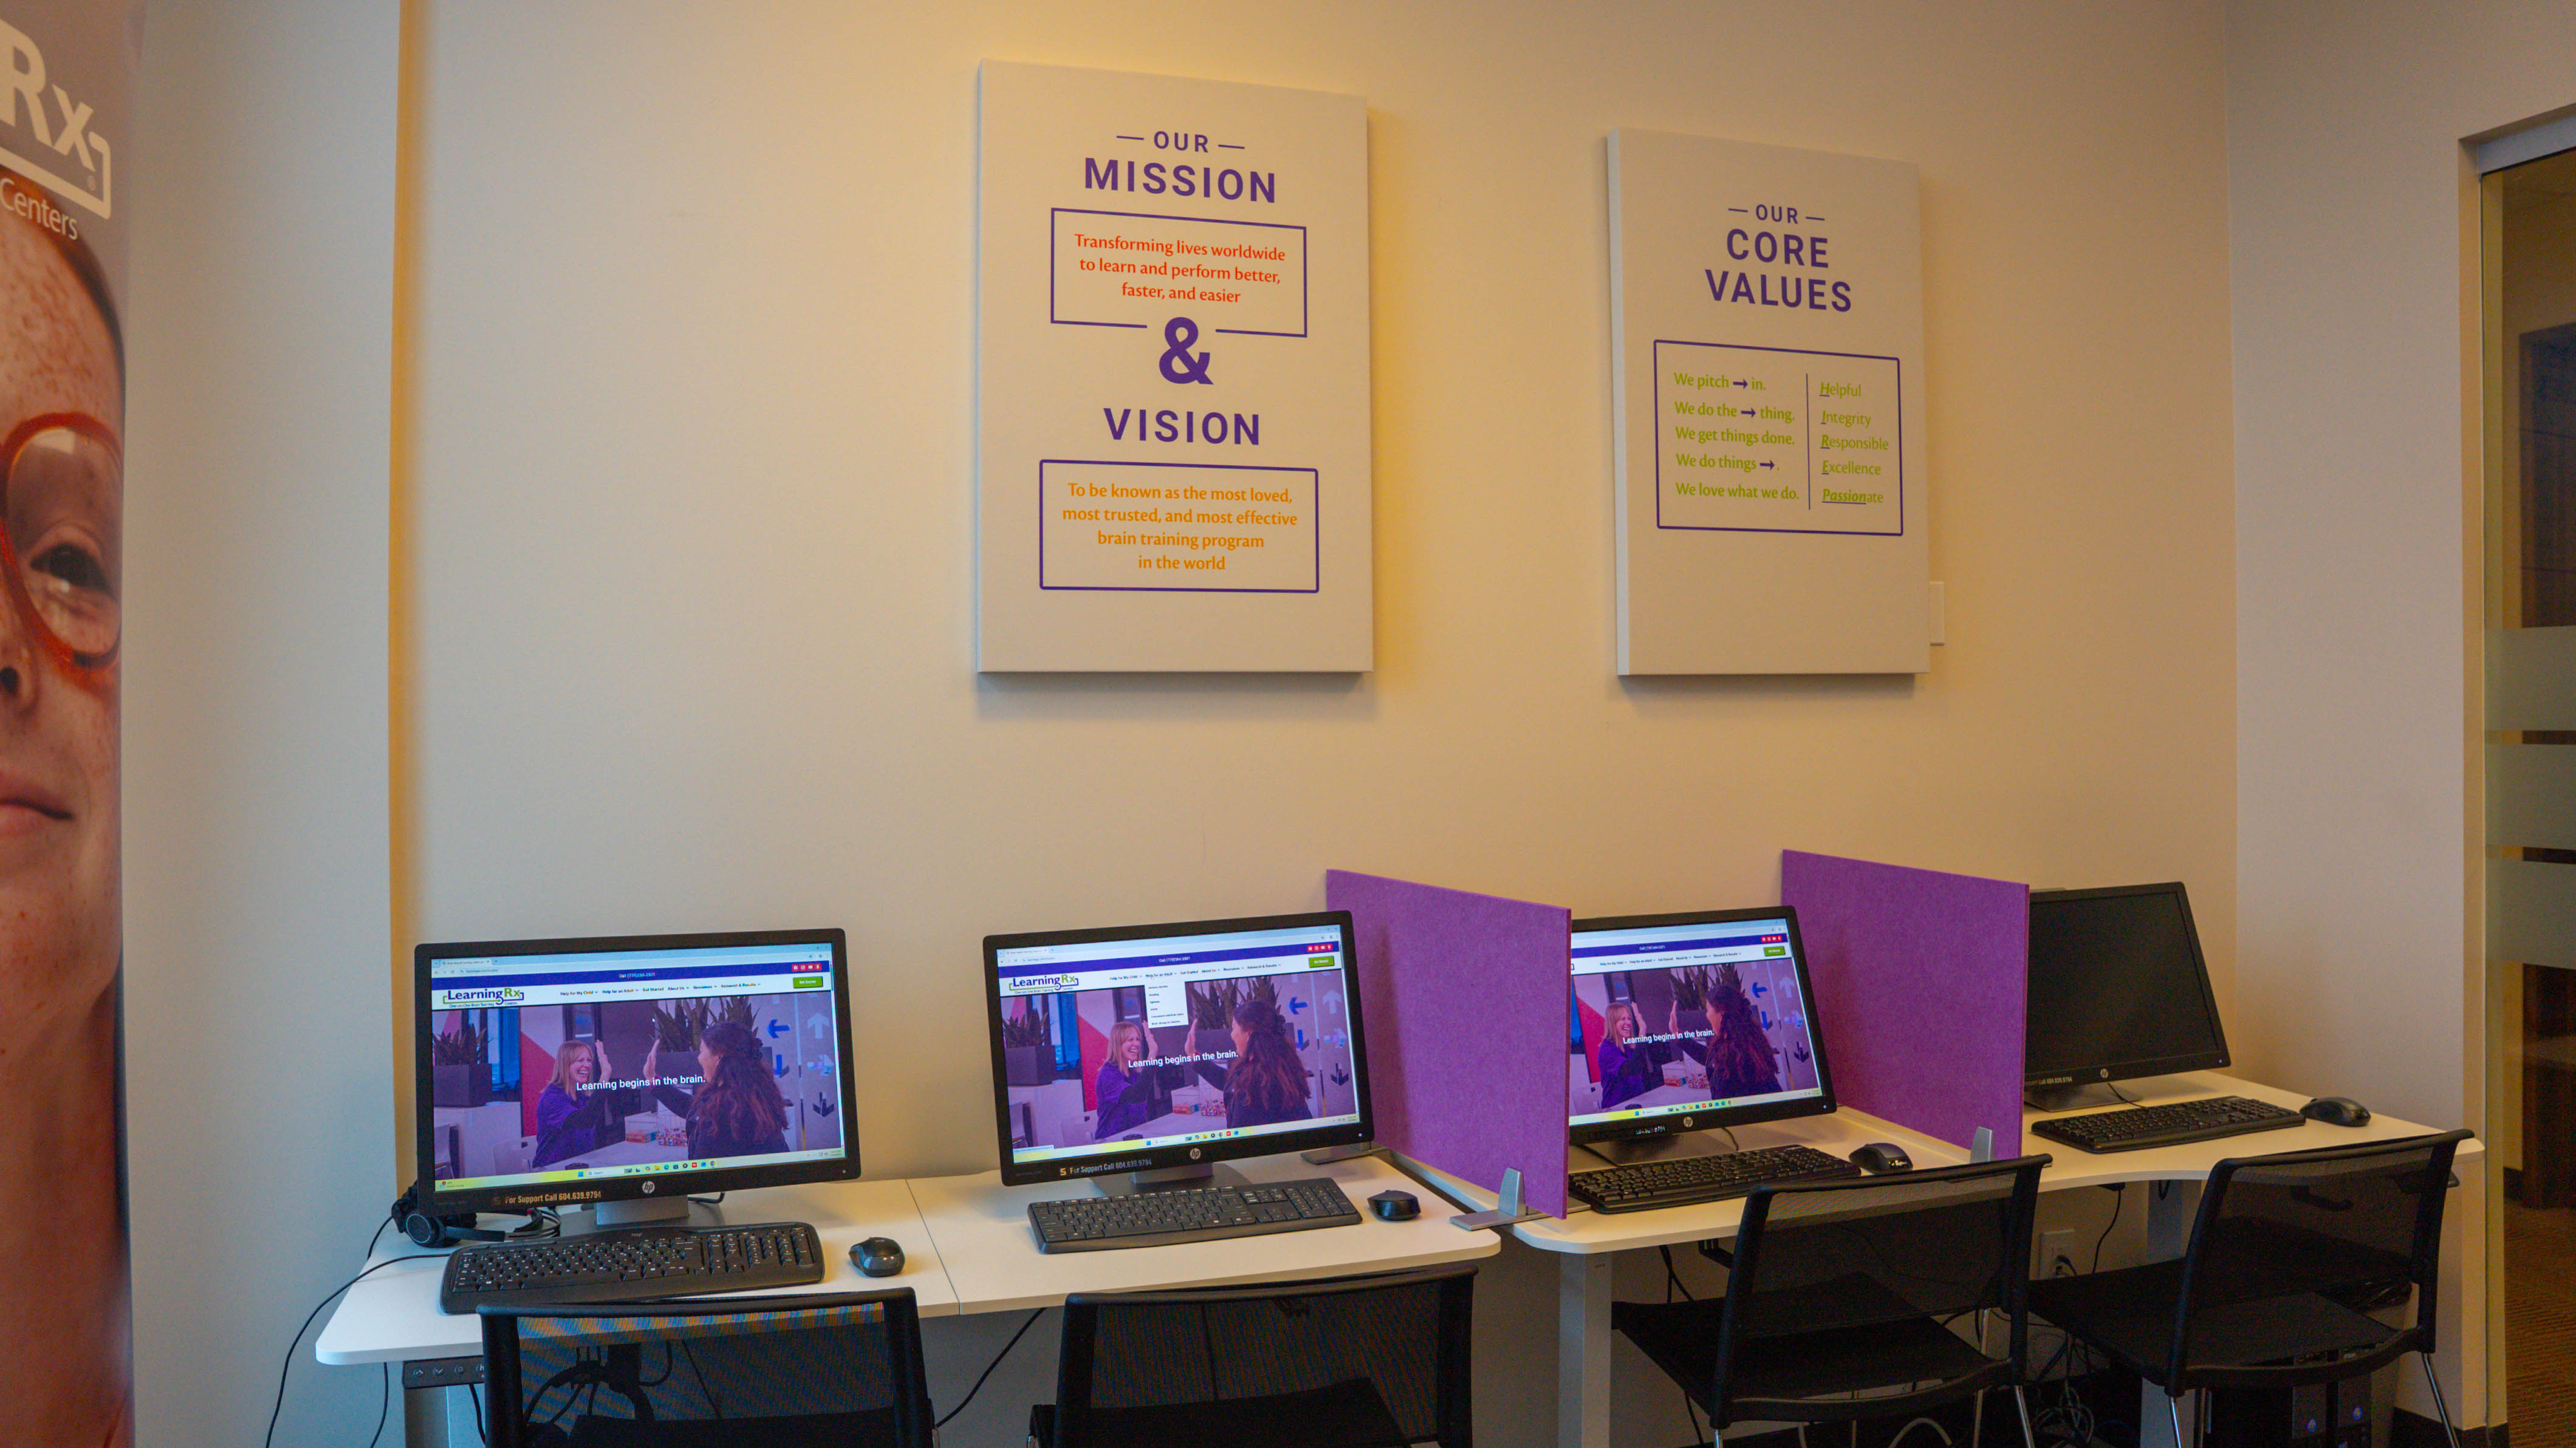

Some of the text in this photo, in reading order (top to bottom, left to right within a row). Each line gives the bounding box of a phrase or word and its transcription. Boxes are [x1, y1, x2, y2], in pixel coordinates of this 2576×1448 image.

[1154, 131, 1208, 152] OUR
[1086, 158, 1275, 203] MISSION
[1, 177, 78, 241] Centers
[1756, 204, 1798, 224] OUR
[1074, 234, 1285, 261] Transforming lives worldwide
[1727, 229, 1828, 268] CORE
[1080, 258, 1279, 284] to learn and perform better,
[1122, 282, 1241, 302] faster, and easier
[1705, 270, 1851, 312] VALUES
[1159, 317, 1213, 384] &
[1673, 372, 1766, 391] We pitch in.
[1819, 381, 1861, 398] Helpful
[1674, 401, 1795, 423] We do the thing.
[1820, 410, 1871, 428] Integrity
[1103, 408, 1259, 445] VISION
[1675, 426, 1795, 446] We get things done.
[1820, 434, 1888, 451] Responsible
[1676, 453, 1756, 473] We do things
[1821, 460, 1881, 475] Excellence
[1067, 482, 1292, 504] To be known as the most loved,
[1676, 482, 1799, 499] We love what we do.
[1822, 488, 1883, 505] Passionate
[1063, 508, 1298, 525] most trusted, and most effective
[1098, 530, 1264, 551] brain training program
[1139, 555, 1225, 570] in the world
[1013, 974, 1075, 990] LearningRx
[448, 987, 521, 1005] LearningRx
[1623, 1035, 1653, 1044] Learning
[1653, 1033, 1676, 1042] begins
[1128, 1050, 1239, 1068] Learning begins in the brain.
[577, 1074, 705, 1091] Learning begins in the brain.
[1685, 1117, 1693, 1127] hp
[1190, 1147, 1201, 1159] hp
[1080, 1164, 1103, 1173] Support
[643, 1181, 654, 1194] hp
[518, 1195, 543, 1204] Support
[544, 1194, 557, 1203] Call
[558, 1190, 601, 1201] 604.639.9794
